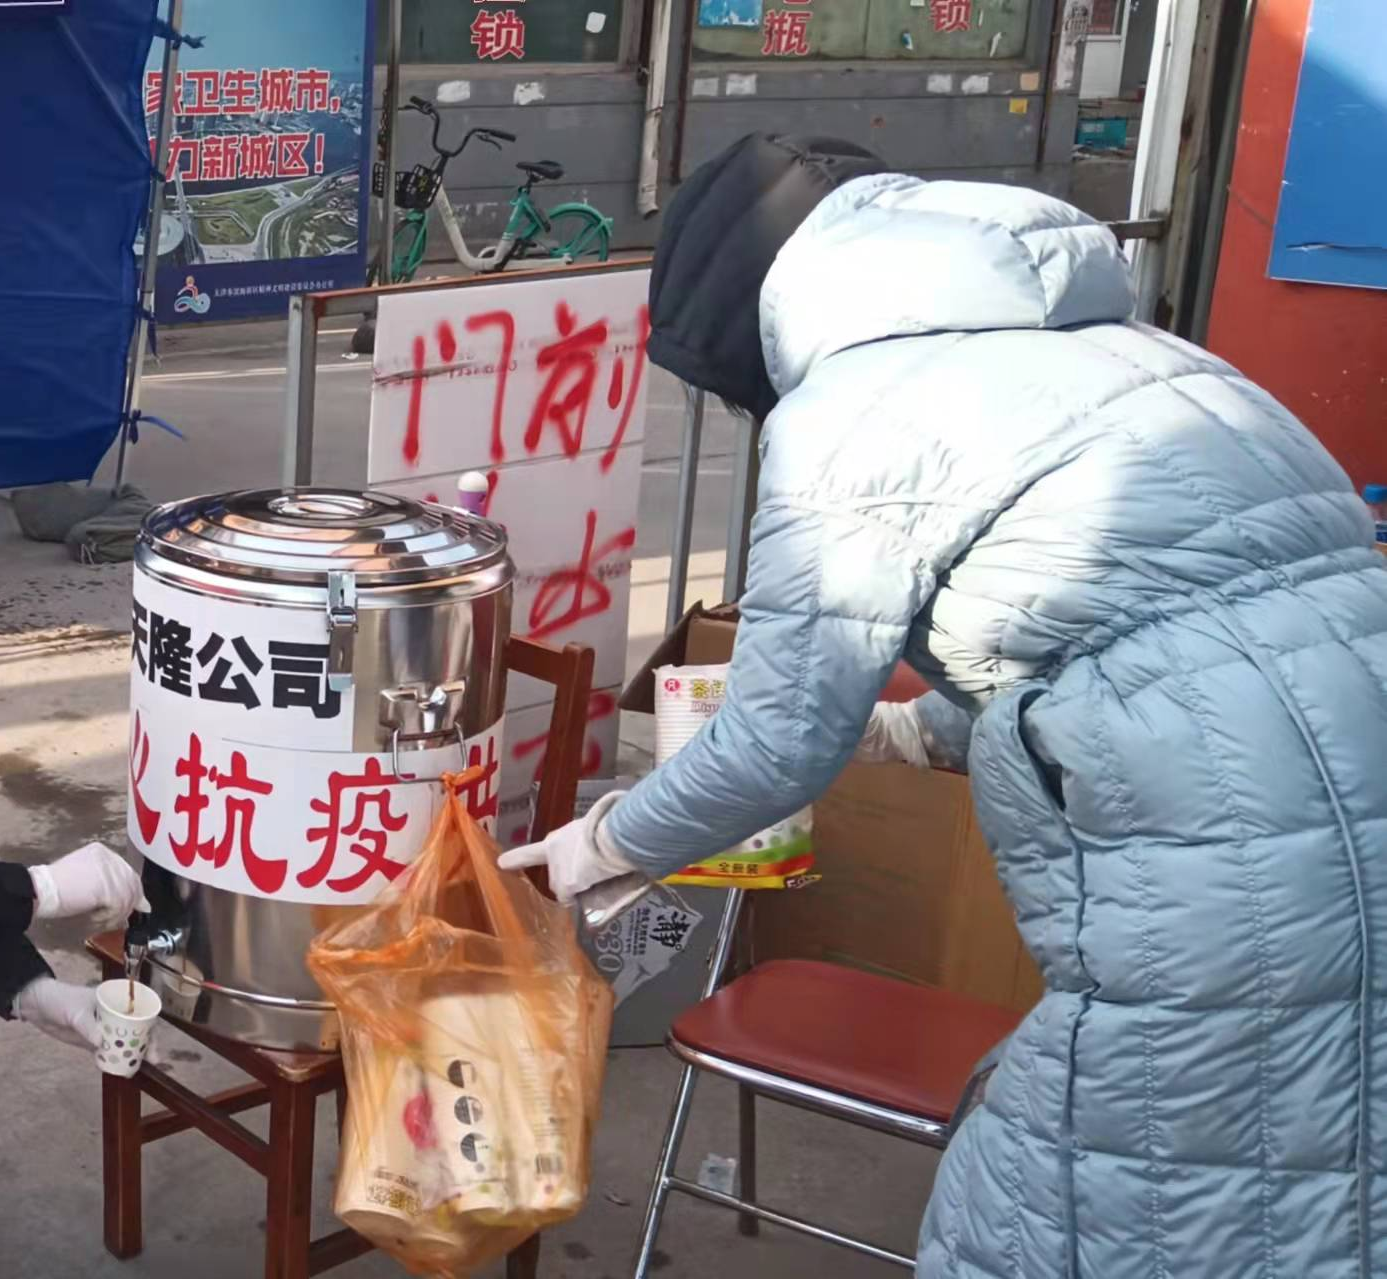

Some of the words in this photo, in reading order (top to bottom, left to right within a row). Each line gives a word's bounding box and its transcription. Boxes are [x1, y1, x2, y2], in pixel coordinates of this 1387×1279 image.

[470, 0, 525, 60] 锁
[761, 0, 813, 56] 瓶
[150, 132, 325, 182] 力新城区！
